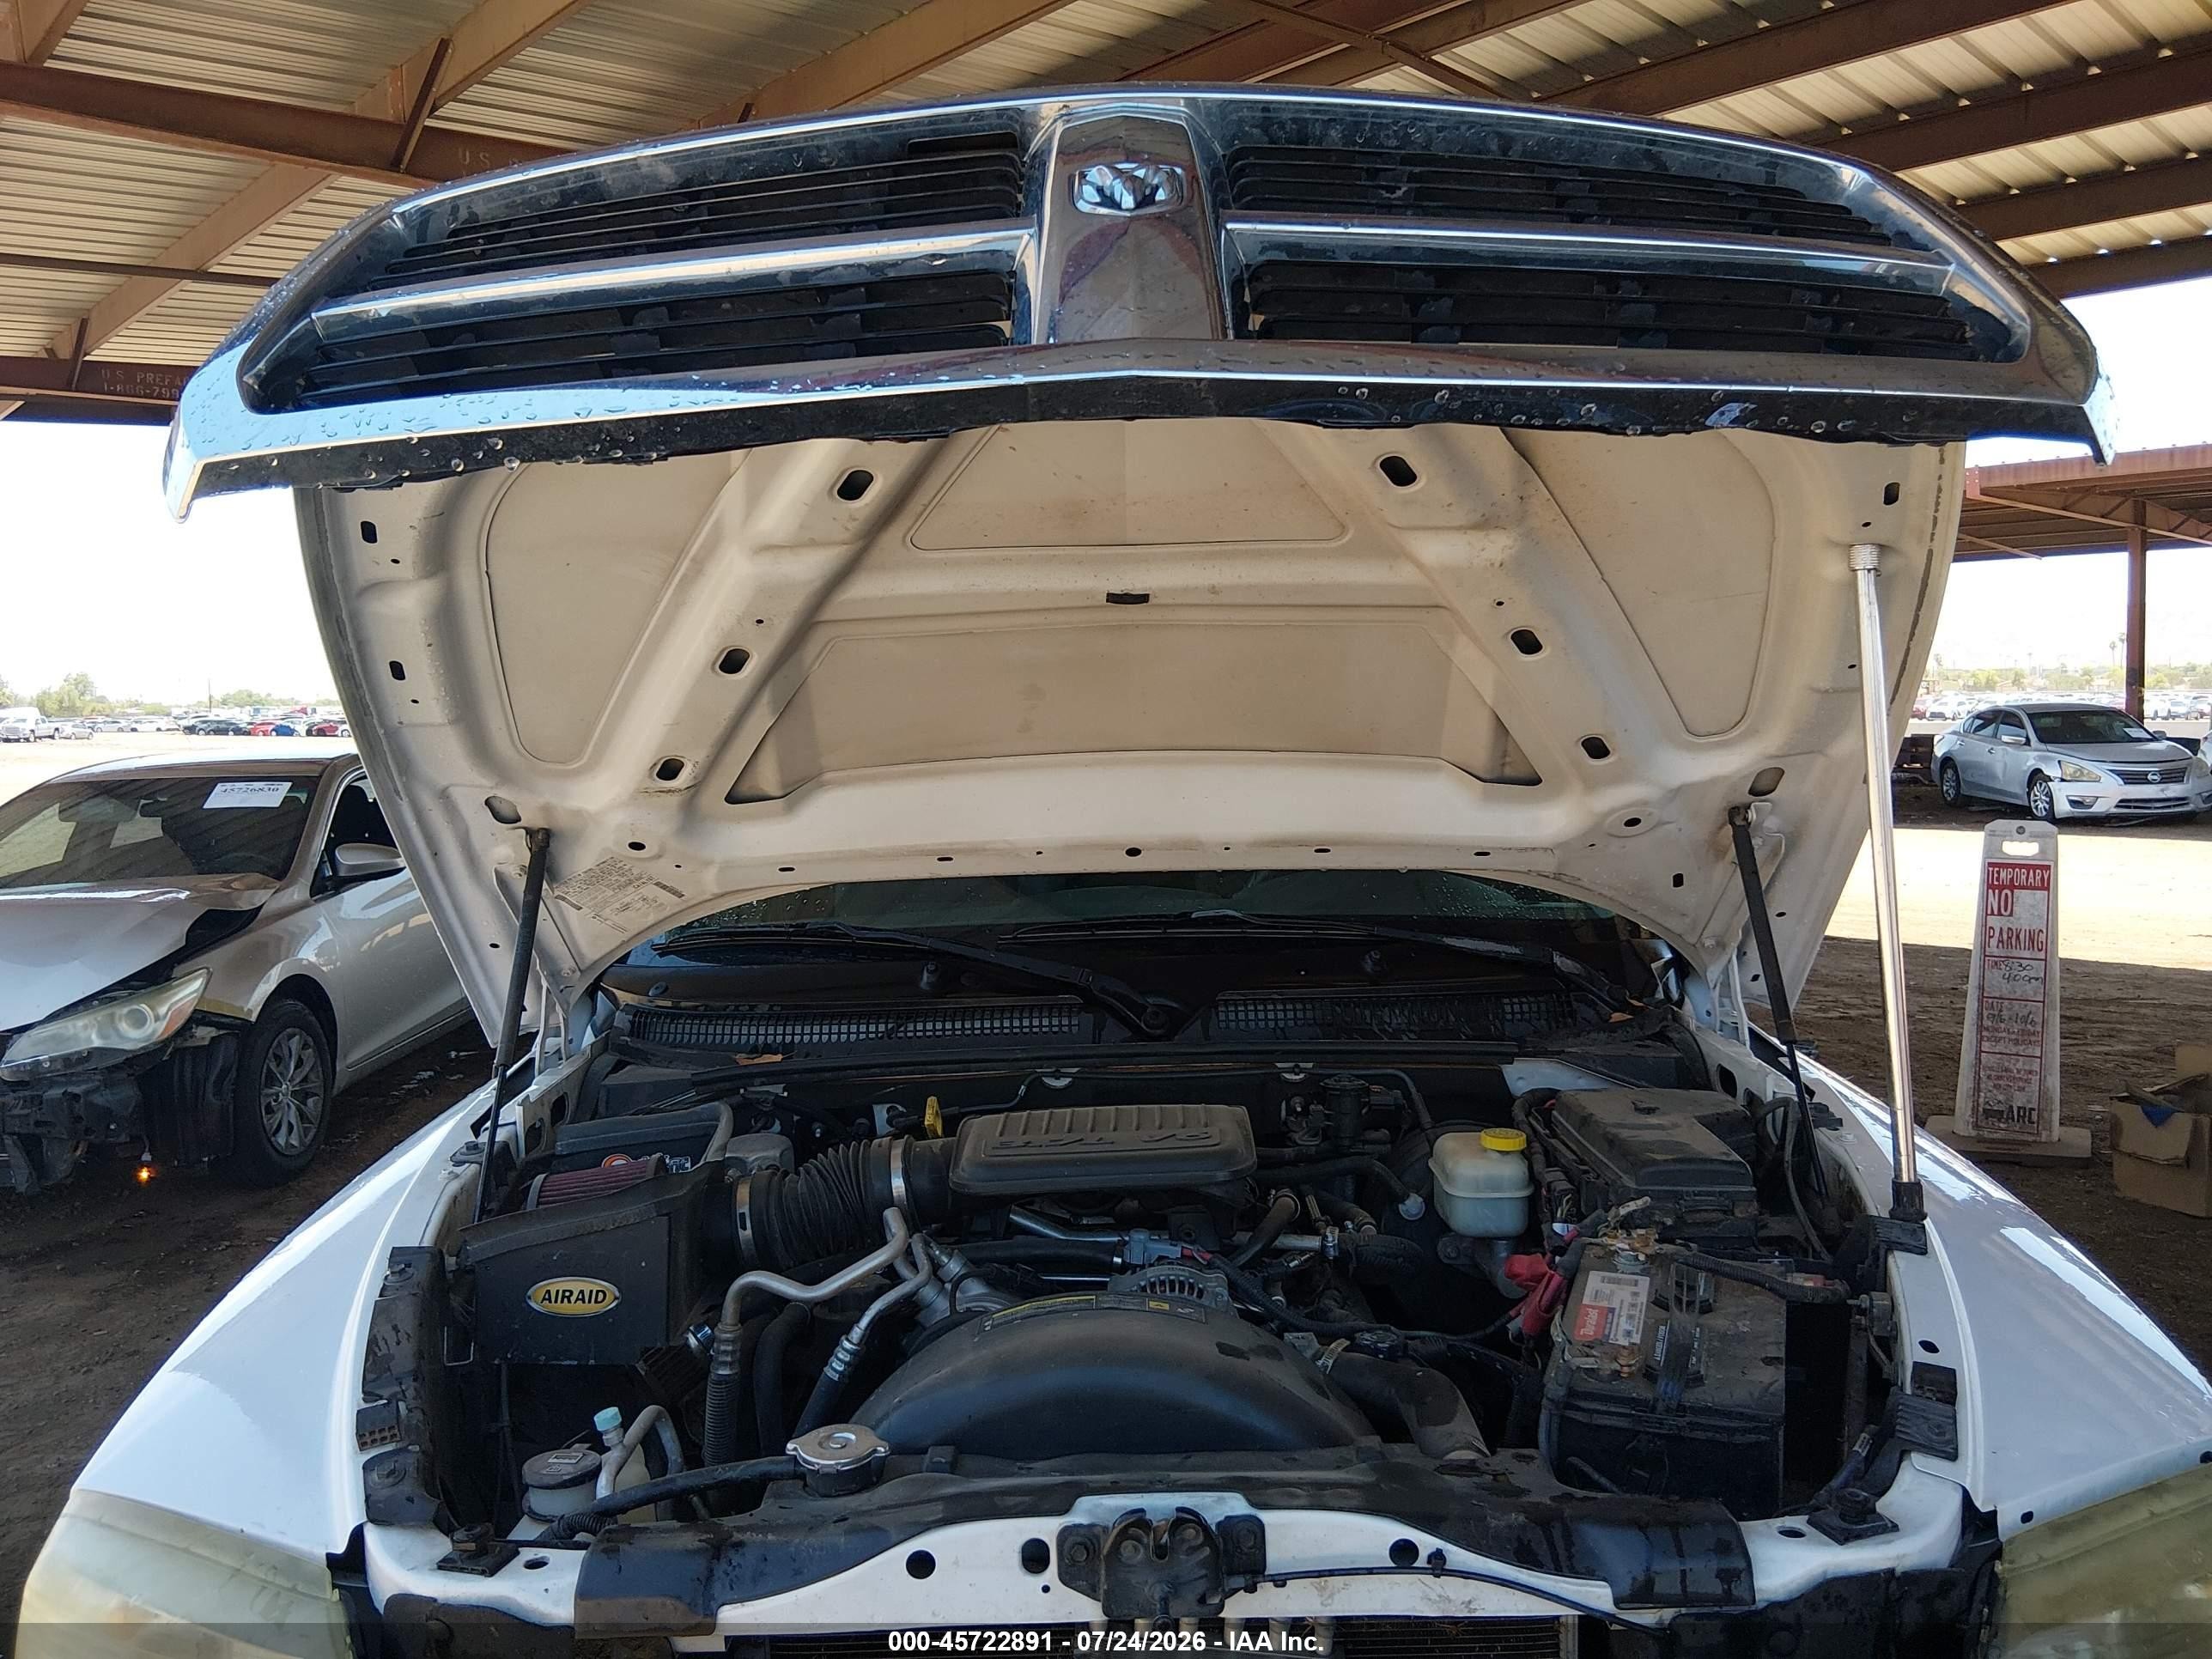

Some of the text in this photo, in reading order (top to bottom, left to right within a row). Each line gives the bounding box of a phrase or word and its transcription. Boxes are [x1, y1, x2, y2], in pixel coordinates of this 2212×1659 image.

[137, 372, 186, 386] PREFA
[1988, 866, 2051, 887] TEMPORARY
[1987, 889, 2012, 916] NO
[1987, 926, 2045, 952] PARKING
[540, 1289, 608, 1304] AIRAID
